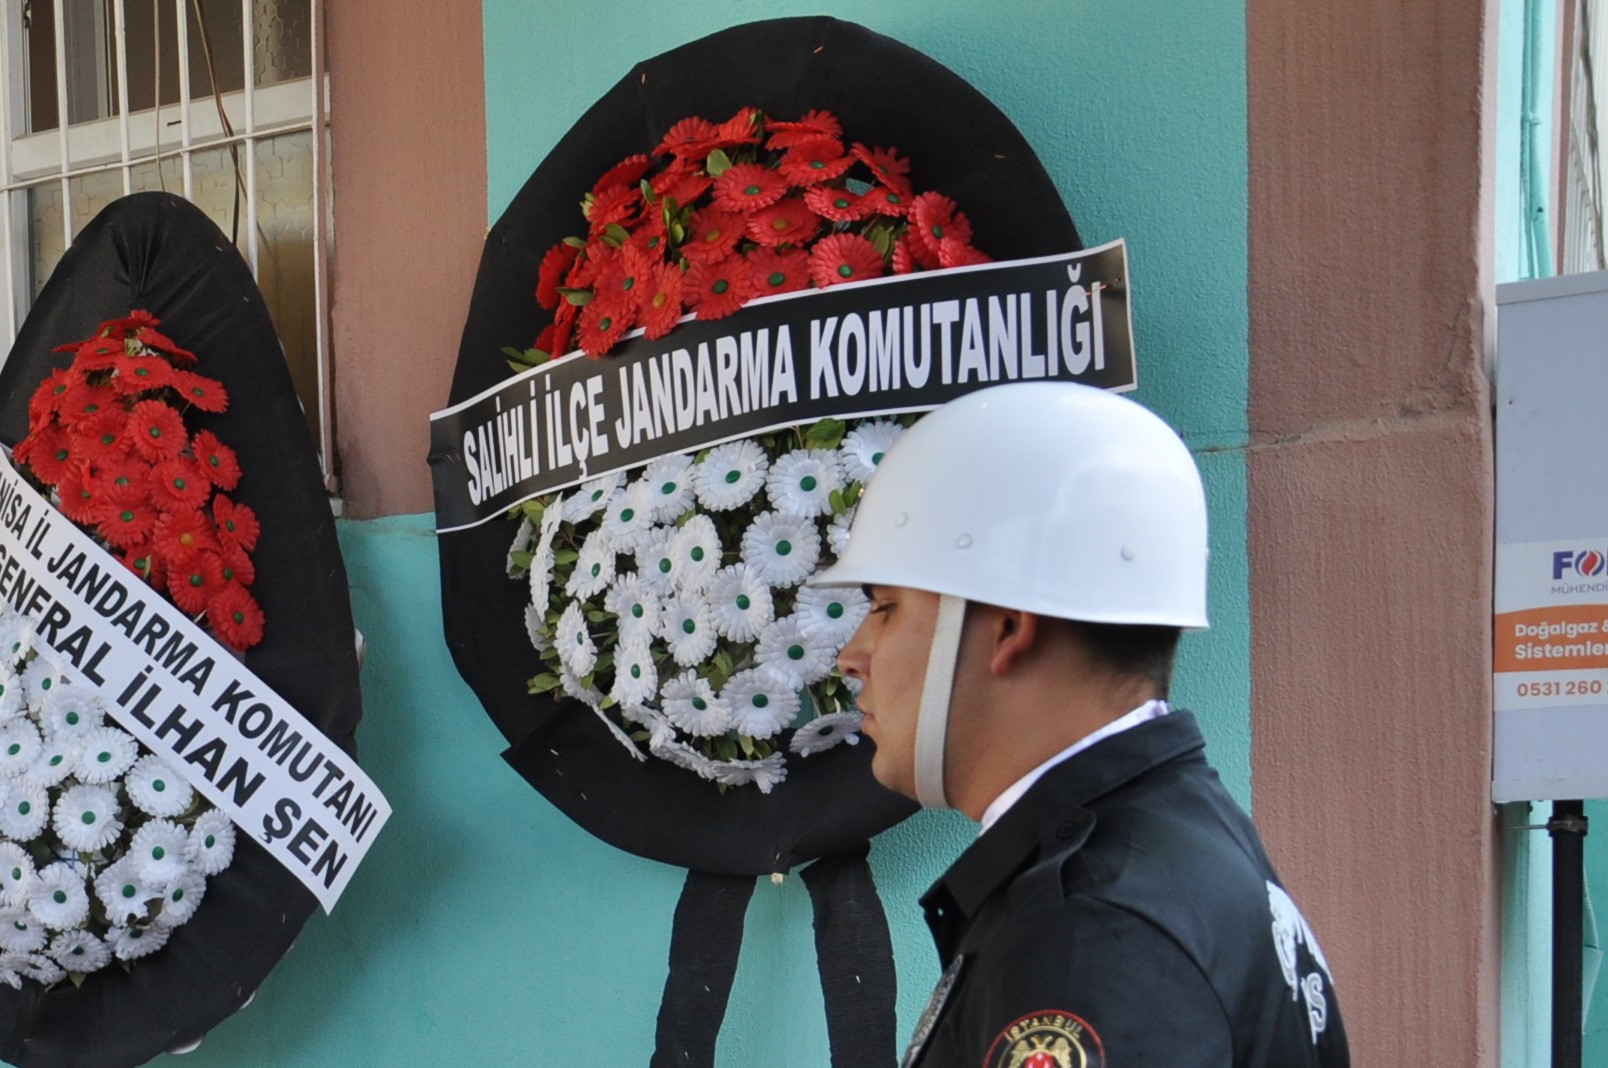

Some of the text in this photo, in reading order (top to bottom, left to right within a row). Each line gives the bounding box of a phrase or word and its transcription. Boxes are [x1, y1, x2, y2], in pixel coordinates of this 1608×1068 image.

[463, 263, 1105, 506] SALİHLİ İLÇE JANDARMA KOMUTANLIĞI
[25, 509, 52, 561] İL
[47, 542, 216, 697] JANDARMA
[211, 678, 378, 844] KOMUTANI
[1514, 621, 1598, 640] Doğalgaz
[1517, 680, 1602, 697] 0531 260
[116, 664, 267, 809] İLHAN
[258, 797, 348, 890] ŞEN
